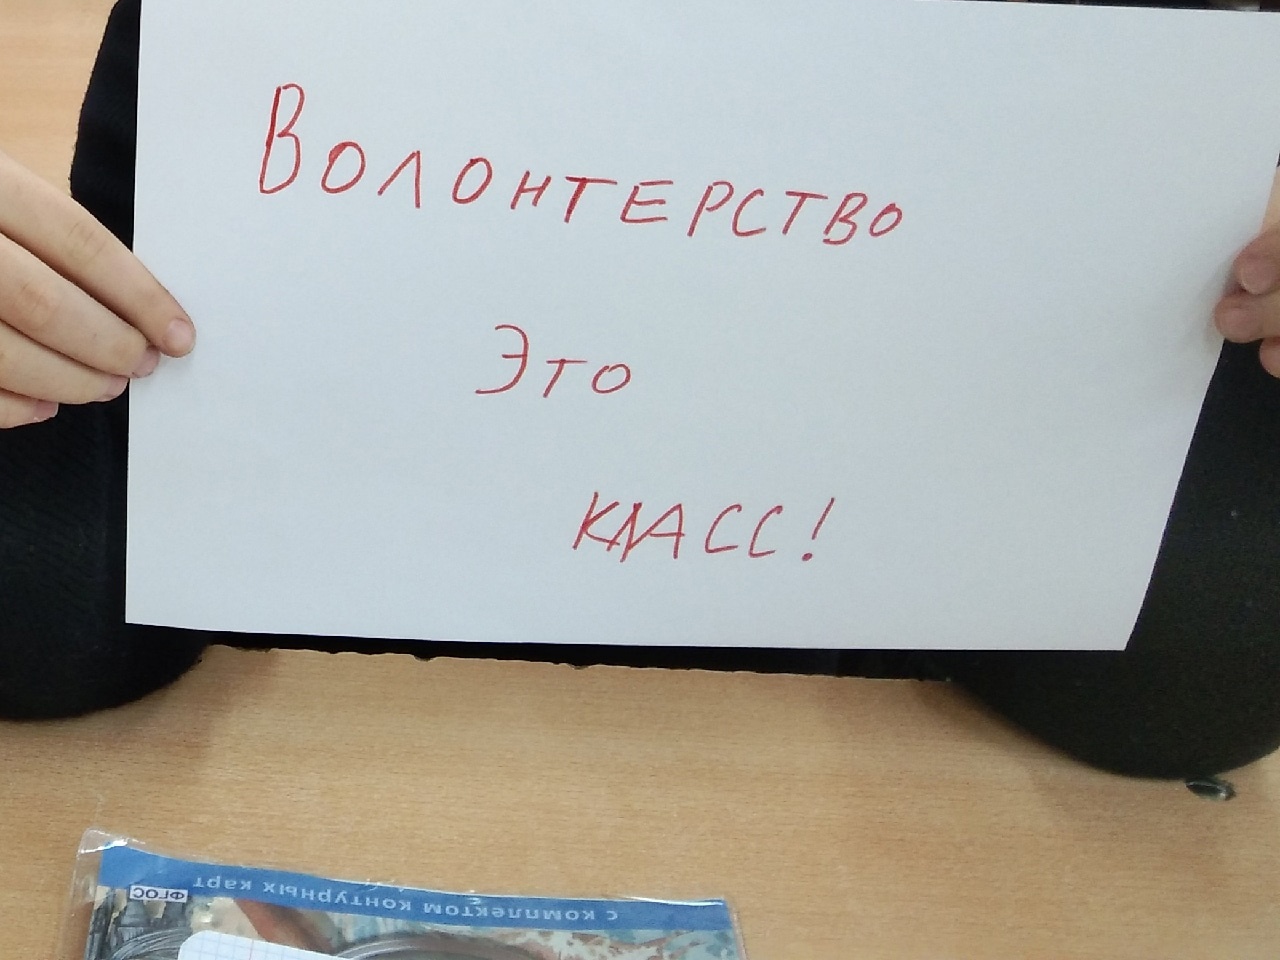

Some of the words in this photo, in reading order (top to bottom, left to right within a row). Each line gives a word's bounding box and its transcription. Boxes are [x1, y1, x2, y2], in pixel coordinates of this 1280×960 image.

[193, 876, 252, 891] карт
[132, 886, 185, 901] ФГОС
[262, 882, 412, 911] контурных
[423, 903, 596, 920] комплектом
